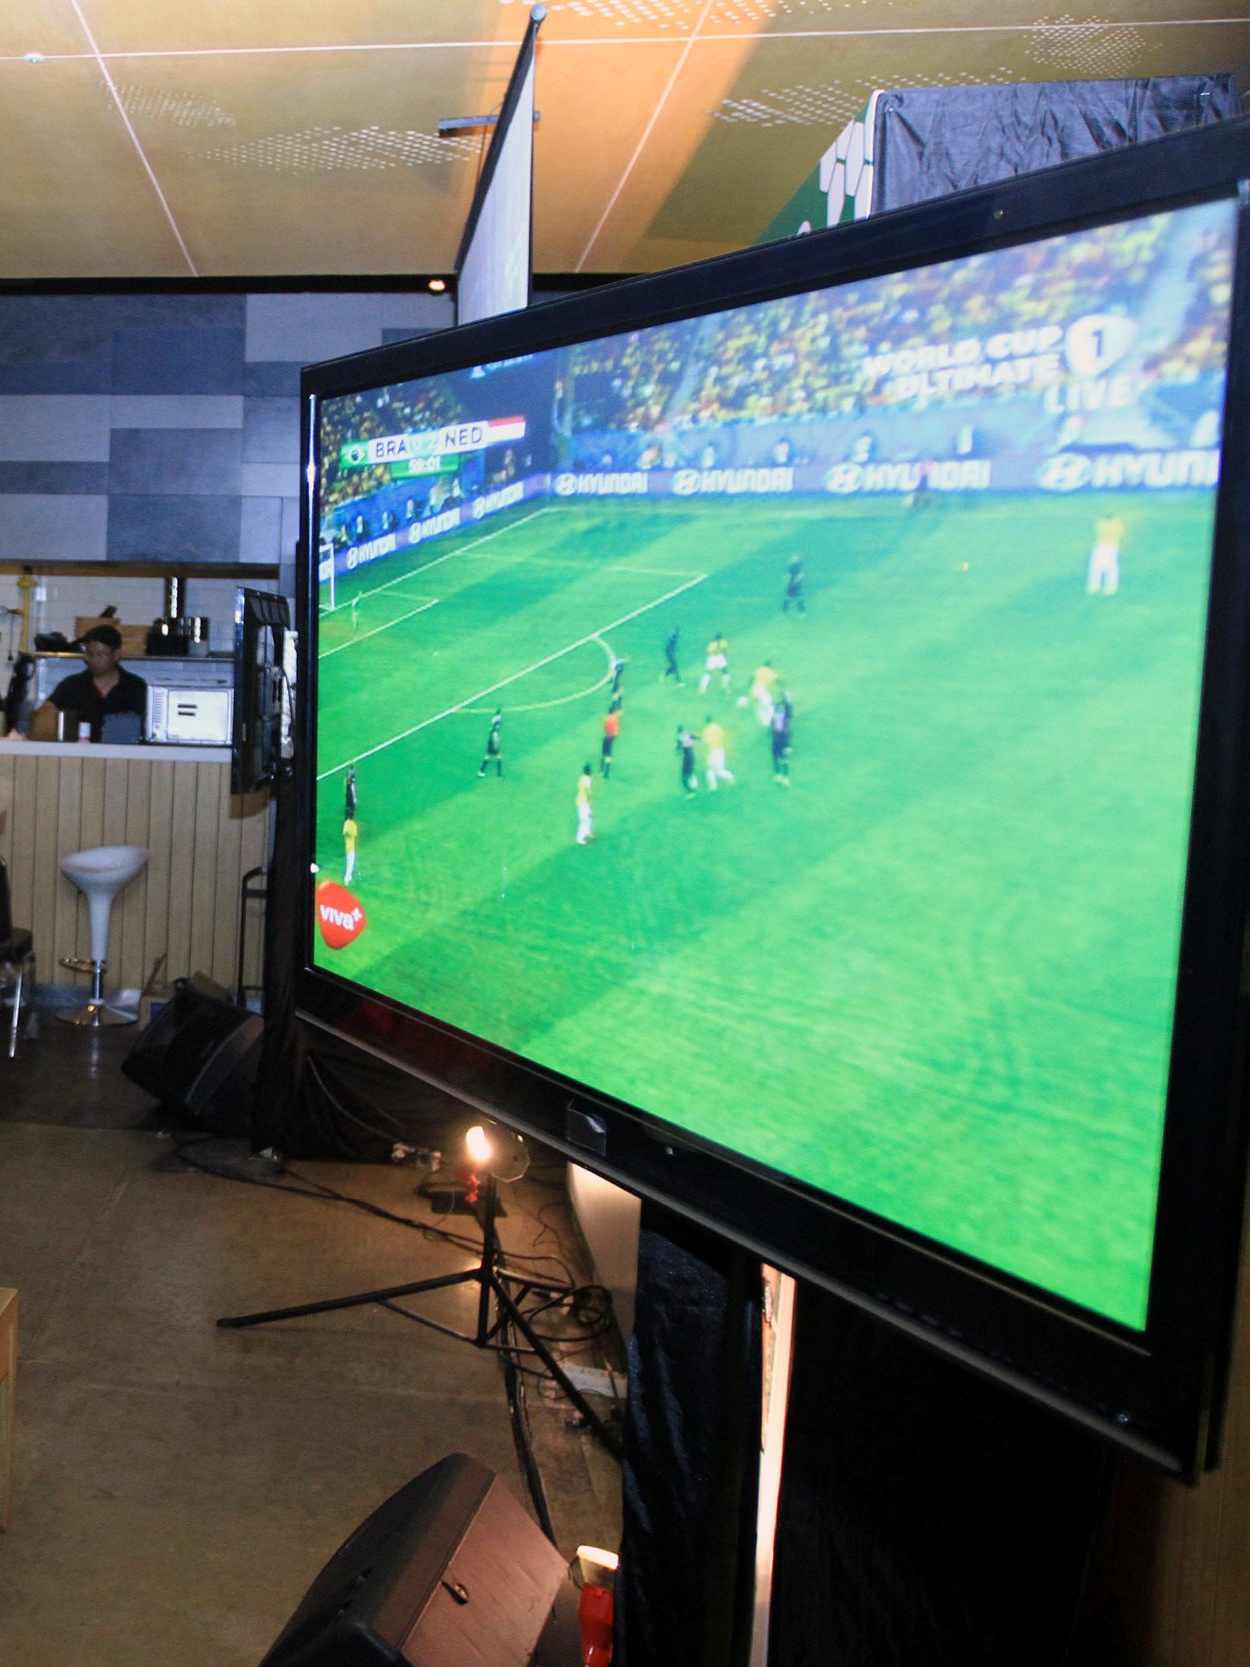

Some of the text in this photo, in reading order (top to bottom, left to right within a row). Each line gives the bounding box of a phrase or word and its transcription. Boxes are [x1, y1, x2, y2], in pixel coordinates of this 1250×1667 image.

[862, 325, 1063, 376] WORLD CUP
[889, 354, 1060, 399] ULTIMATE
[1044, 375, 1134, 415] LIVE
[375, 440, 407, 458] BRA
[445, 427, 483, 448] NED
[578, 472, 648, 494] HYUNDAI
[701, 467, 793, 493] HYUNDAI
